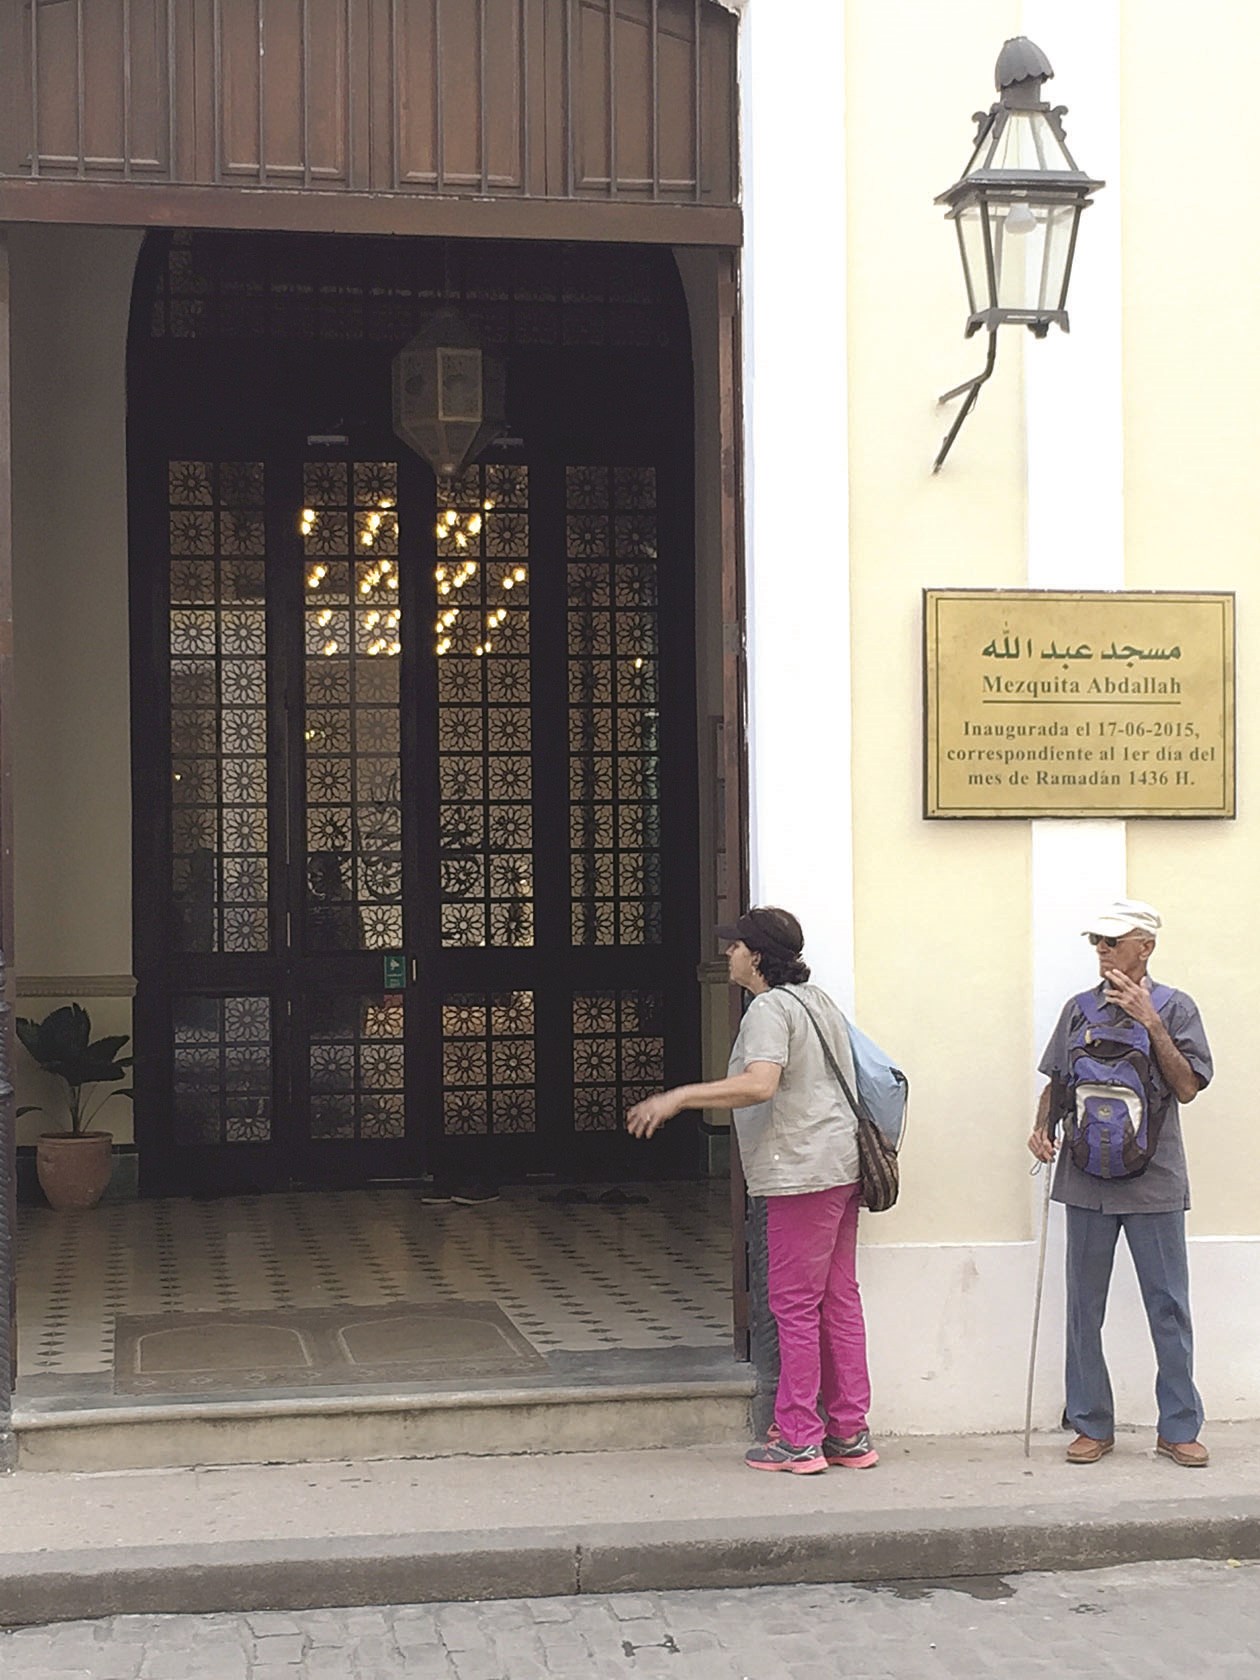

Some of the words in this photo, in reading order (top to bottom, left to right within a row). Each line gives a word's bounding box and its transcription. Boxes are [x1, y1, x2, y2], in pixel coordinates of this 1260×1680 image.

[1041, 644, 1092, 669] عبد
[1101, 644, 1181, 667] مسجد
[982, 676, 1080, 697] Mezquita
[1087, 677, 1181, 694] Abdallah
[964, 721, 1069, 739] Inaugurada
[1076, 722, 1090, 736] el
[1099, 722, 1199, 740] 17-06-2015,
[947, 746, 1092, 765] correspondiente
[1099, 747, 1114, 761] al
[1156, 747, 1182, 761] día
[1190, 747, 1215, 761] del
[968, 773, 1002, 785] mes
[1009, 771, 1029, 785] de
[1036, 771, 1120, 785] Ramadán
[1129, 771, 1168, 786] 1436
[1175, 772, 1194, 785] H.
